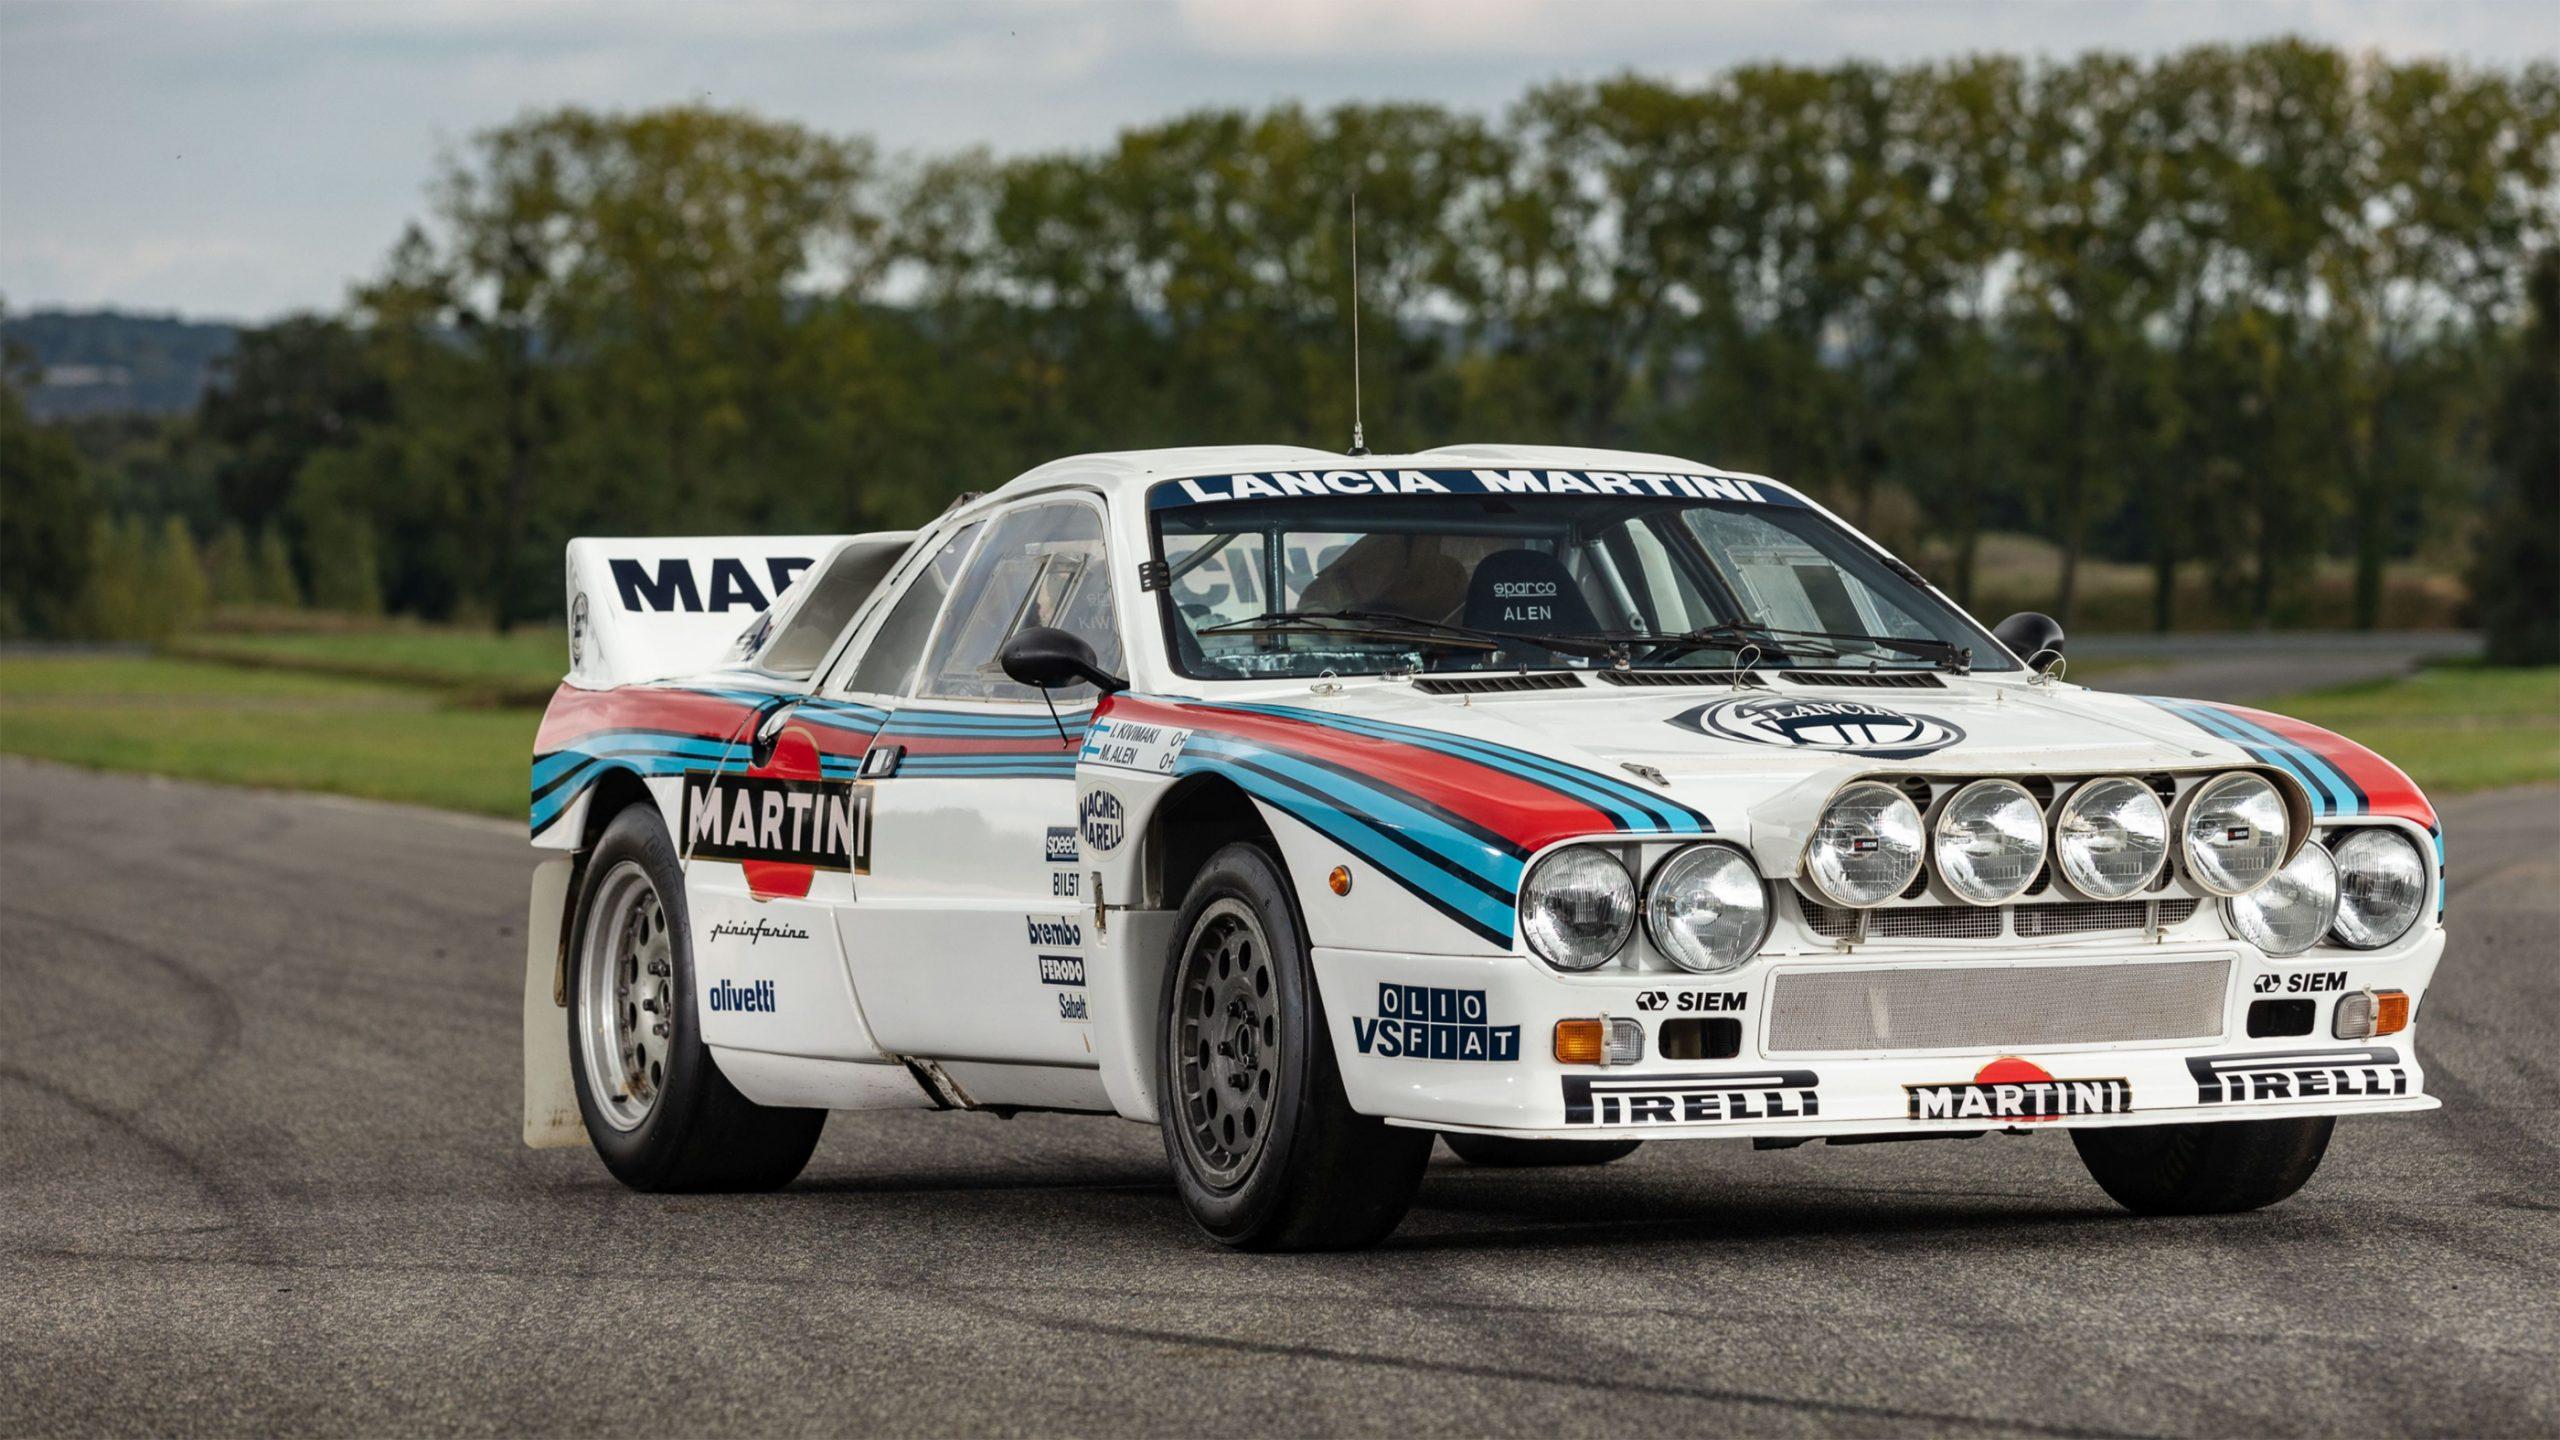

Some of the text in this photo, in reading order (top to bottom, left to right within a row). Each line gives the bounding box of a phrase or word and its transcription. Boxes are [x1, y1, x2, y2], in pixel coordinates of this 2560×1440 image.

[1178, 469, 1768, 503] LANCIA MARTINI
[1493, 581, 1558, 599] sparco
[1503, 605, 1553, 621] ALEN
[1764, 702, 1903, 721] LANCIA
[1116, 723, 1162, 744] KIVIMAKI
[1099, 744, 1110, 761] M.
[1110, 746, 1139, 764] ALEN
[688, 785, 868, 857] MARTINI
[1080, 790, 1124, 830] MAGNETI
[1080, 812, 1125, 851] MARELLI
[710, 918, 809, 945] pininfarina
[1027, 915, 1081, 945] brembo
[1040, 958, 1083, 982] FERODO
[2287, 971, 2348, 992] SIEM
[710, 979, 775, 1012] olivetti
[1059, 992, 1088, 1020] Sabelt
[1381, 986, 1484, 1021] OLIO
[1676, 991, 1748, 1011] SIEM
[2184, 1047, 2407, 1104] PIRELLI
[1561, 1070, 1819, 1124] PIRELLI
[1916, 1081, 2123, 1119] MARTINI
